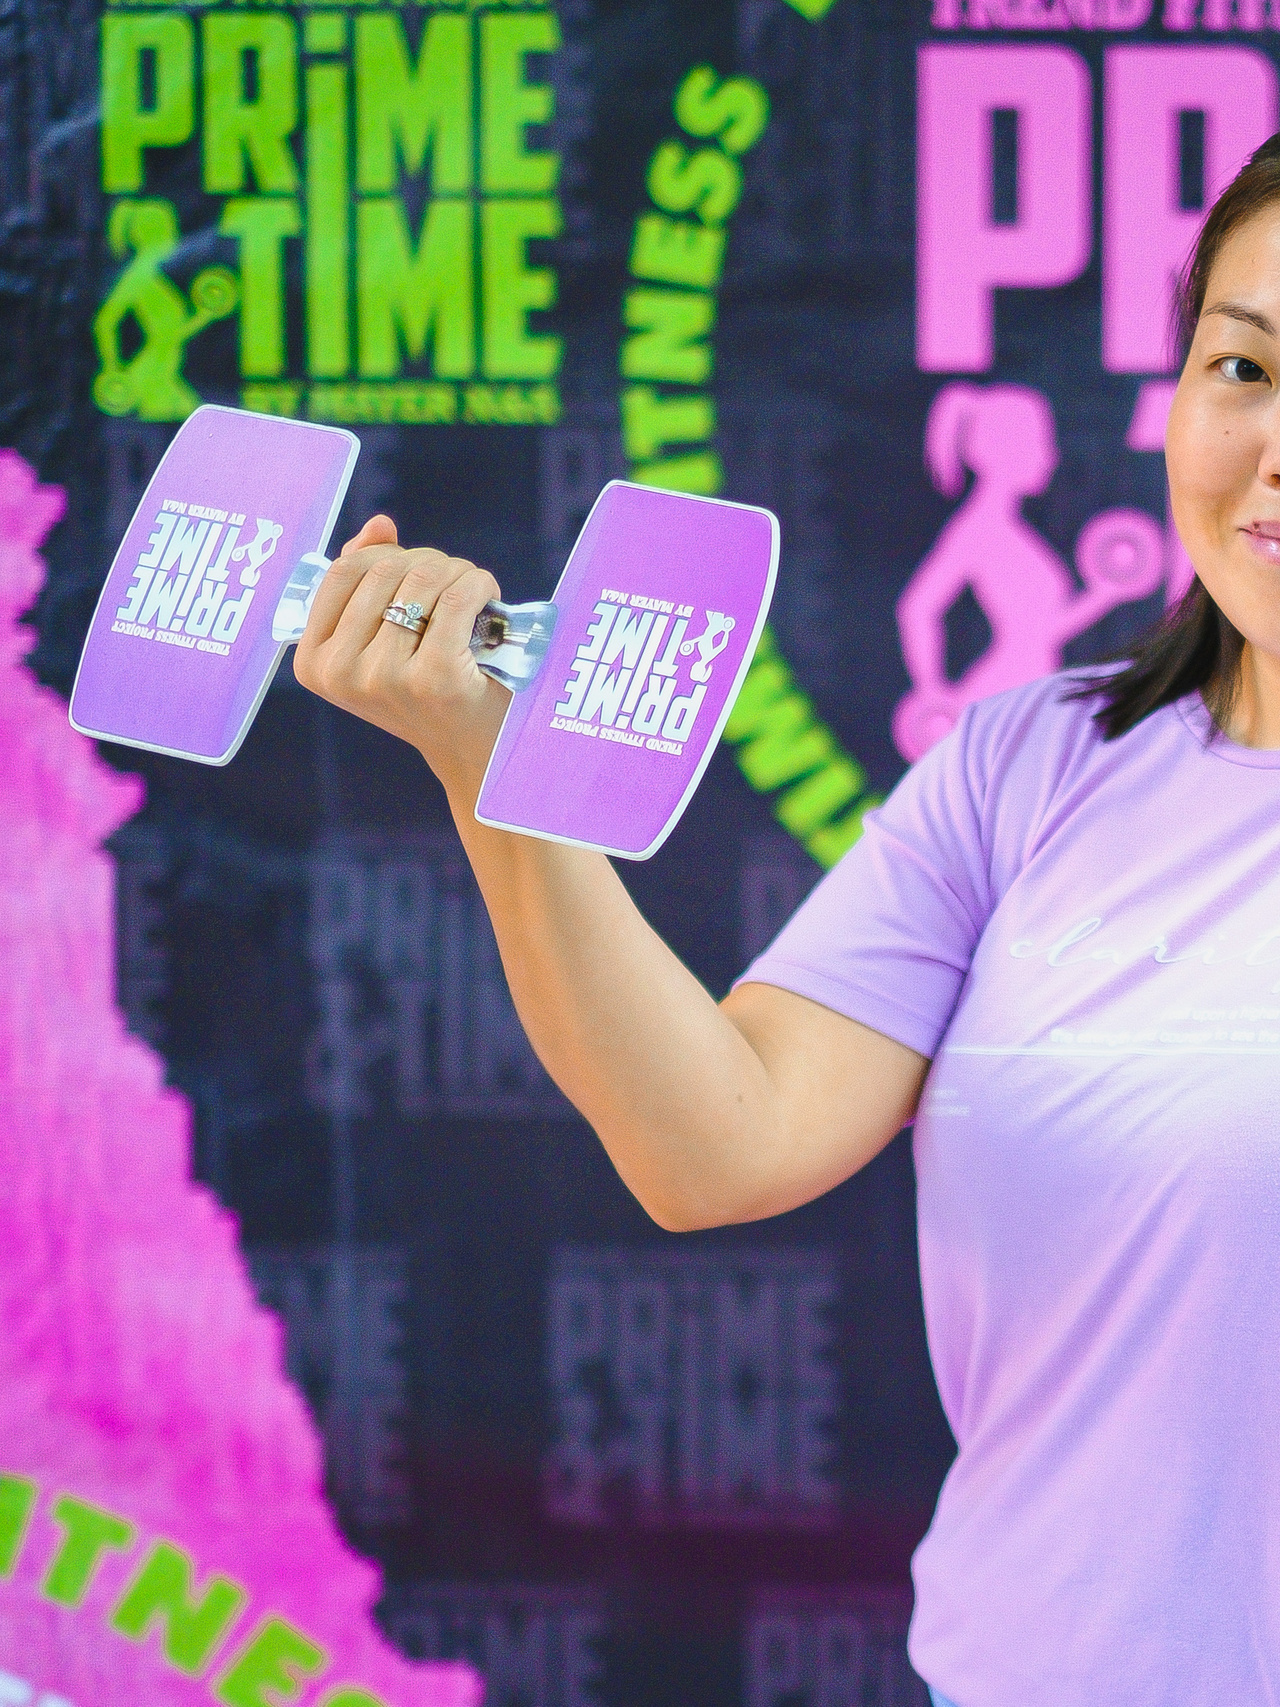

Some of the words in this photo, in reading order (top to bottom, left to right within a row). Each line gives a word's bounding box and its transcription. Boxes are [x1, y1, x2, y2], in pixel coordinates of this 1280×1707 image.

[220, 199, 564, 379] TIME
[620, 64, 770, 494] ITNESS
[138, 511, 241, 582] TIME
[576, 602, 688, 677] TIME
[1214, 1029, 1228, 1043] to
[1258, 1030, 1280, 1044] the
